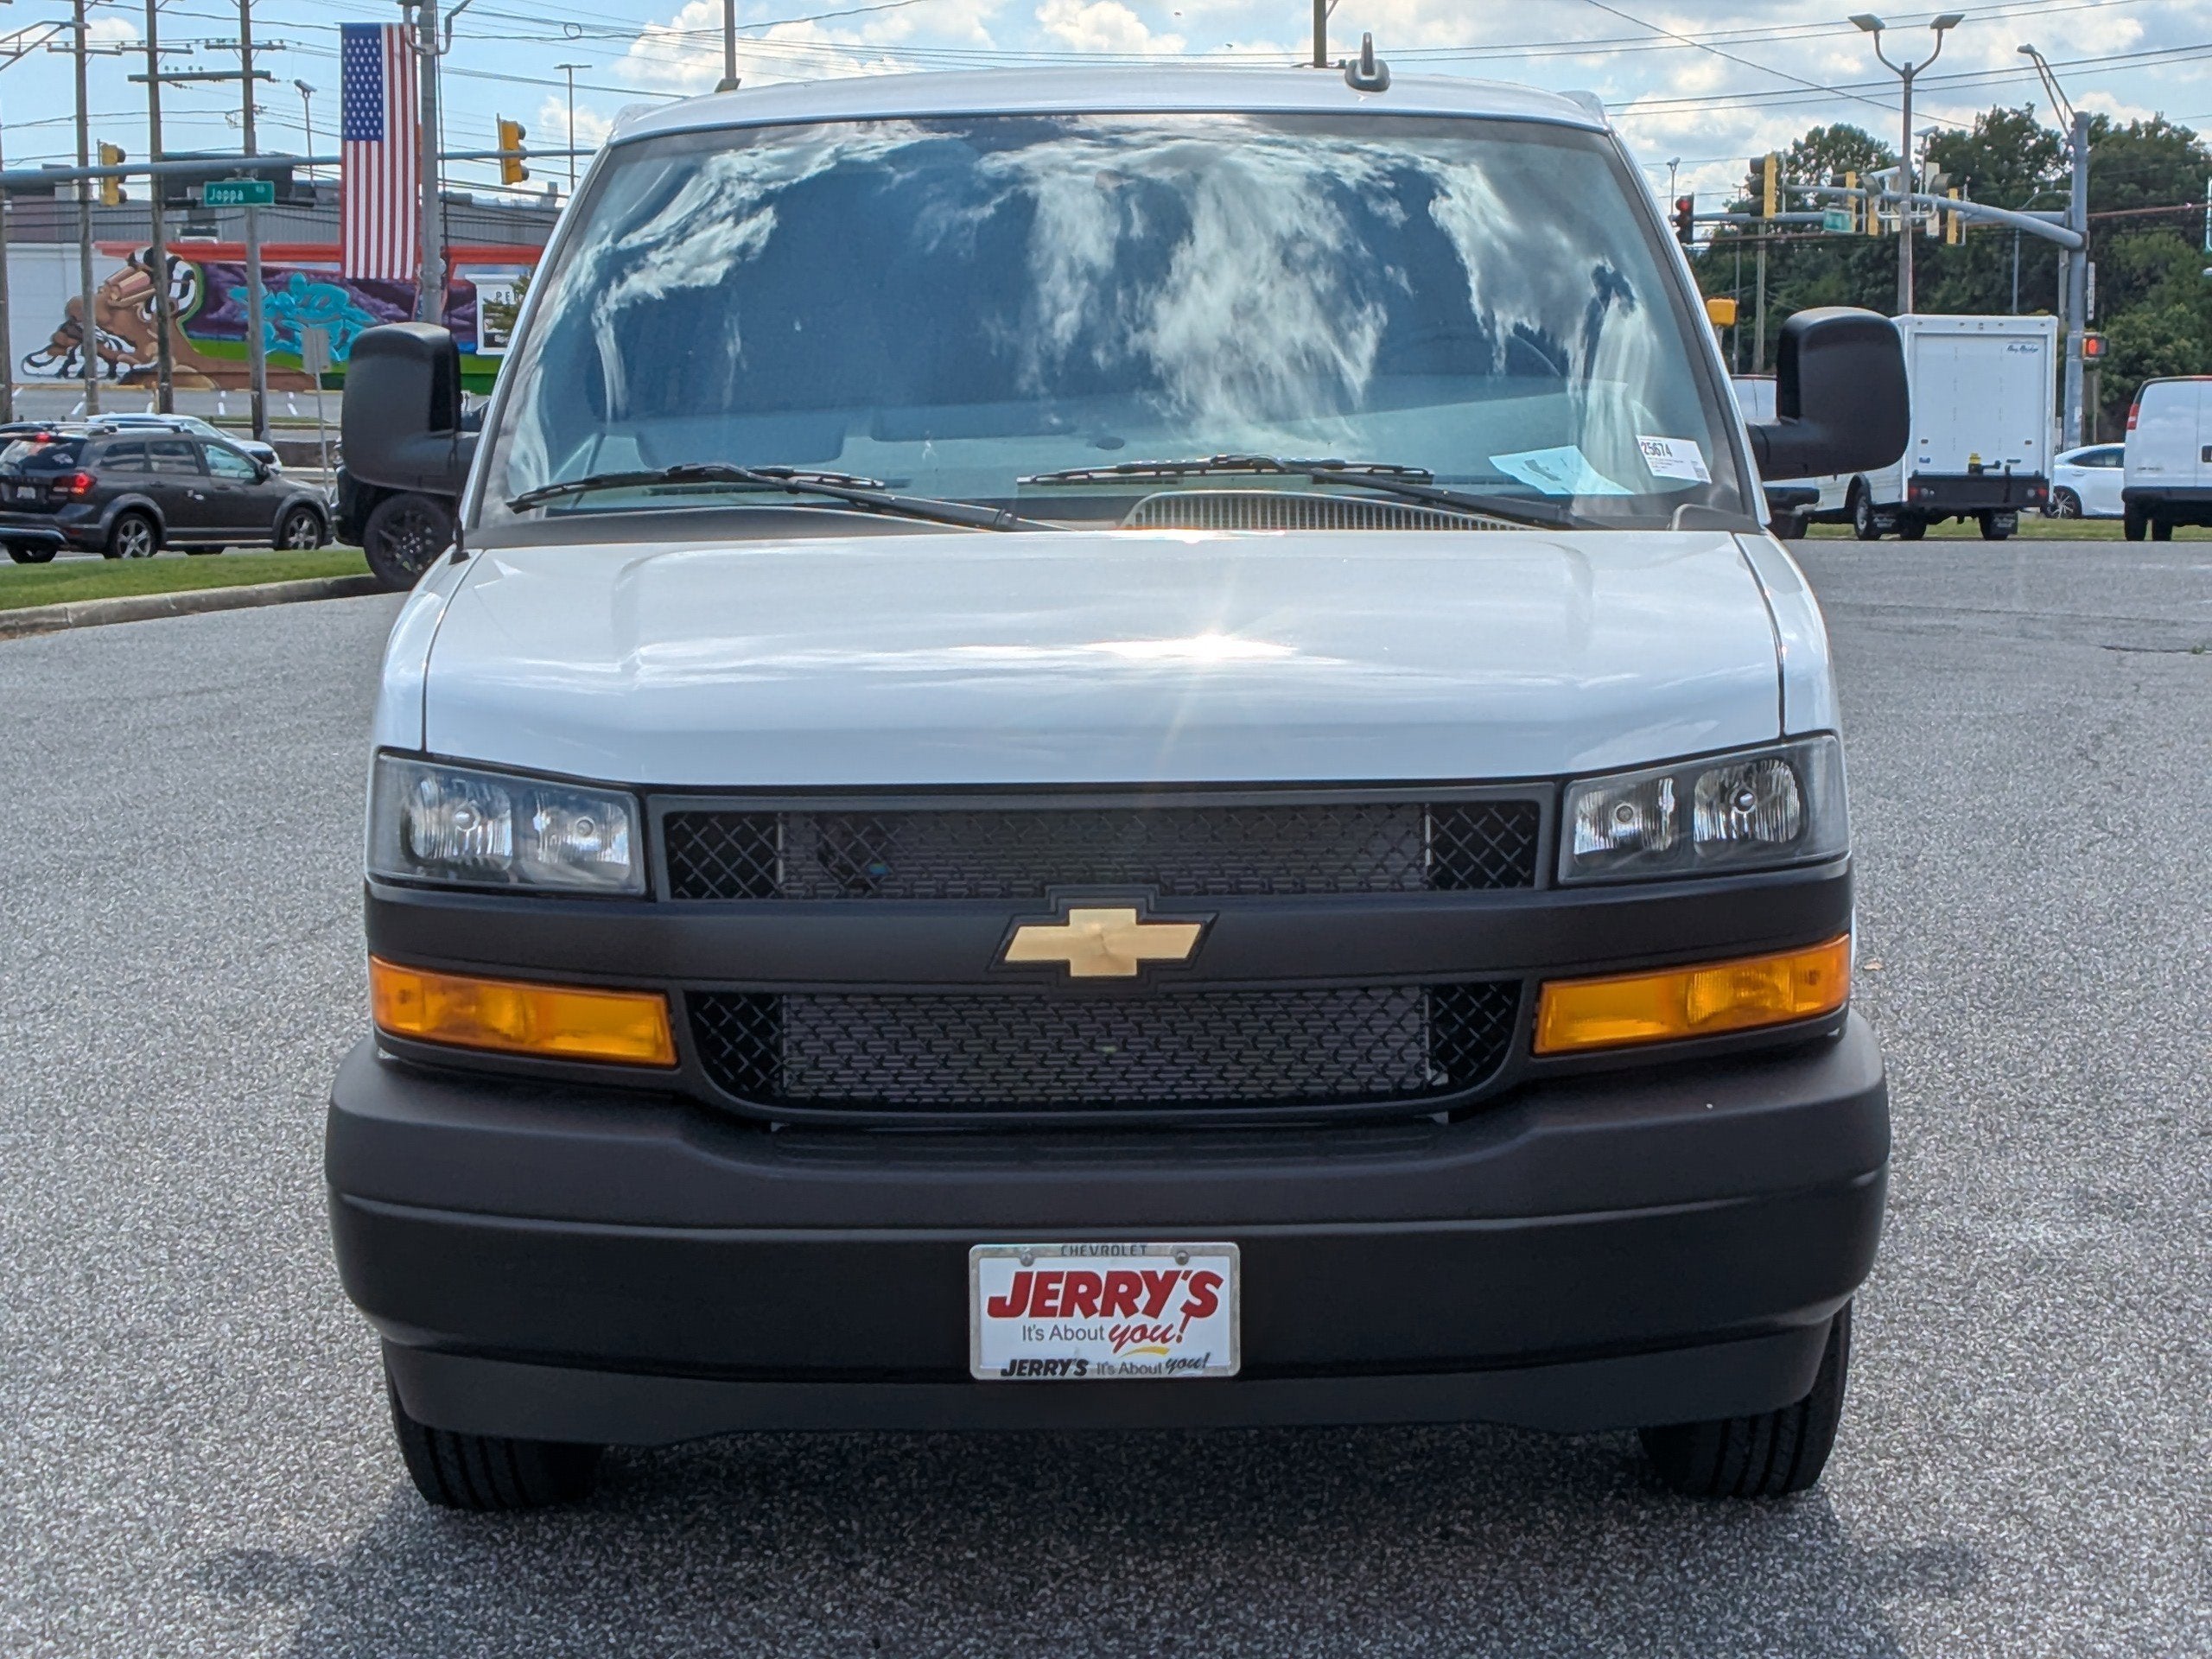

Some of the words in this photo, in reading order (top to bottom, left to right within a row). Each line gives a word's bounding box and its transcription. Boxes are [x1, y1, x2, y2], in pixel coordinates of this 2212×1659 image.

[209, 188, 244, 204] Joppa
[1641, 442, 1673, 458] 25674
[1060, 1244, 1147, 1256] CHEVROLET
[987, 1269, 1224, 1319] JERRY'S
[1022, 1324, 1045, 1341] It's
[1049, 1324, 1104, 1341] About
[1108, 1313, 1188, 1353] you!
[1000, 1358, 1090, 1376] JERRY'S
[1096, 1363, 1116, 1376] It's
[1120, 1361, 1162, 1375] About
[1165, 1352, 1211, 1374] you!
